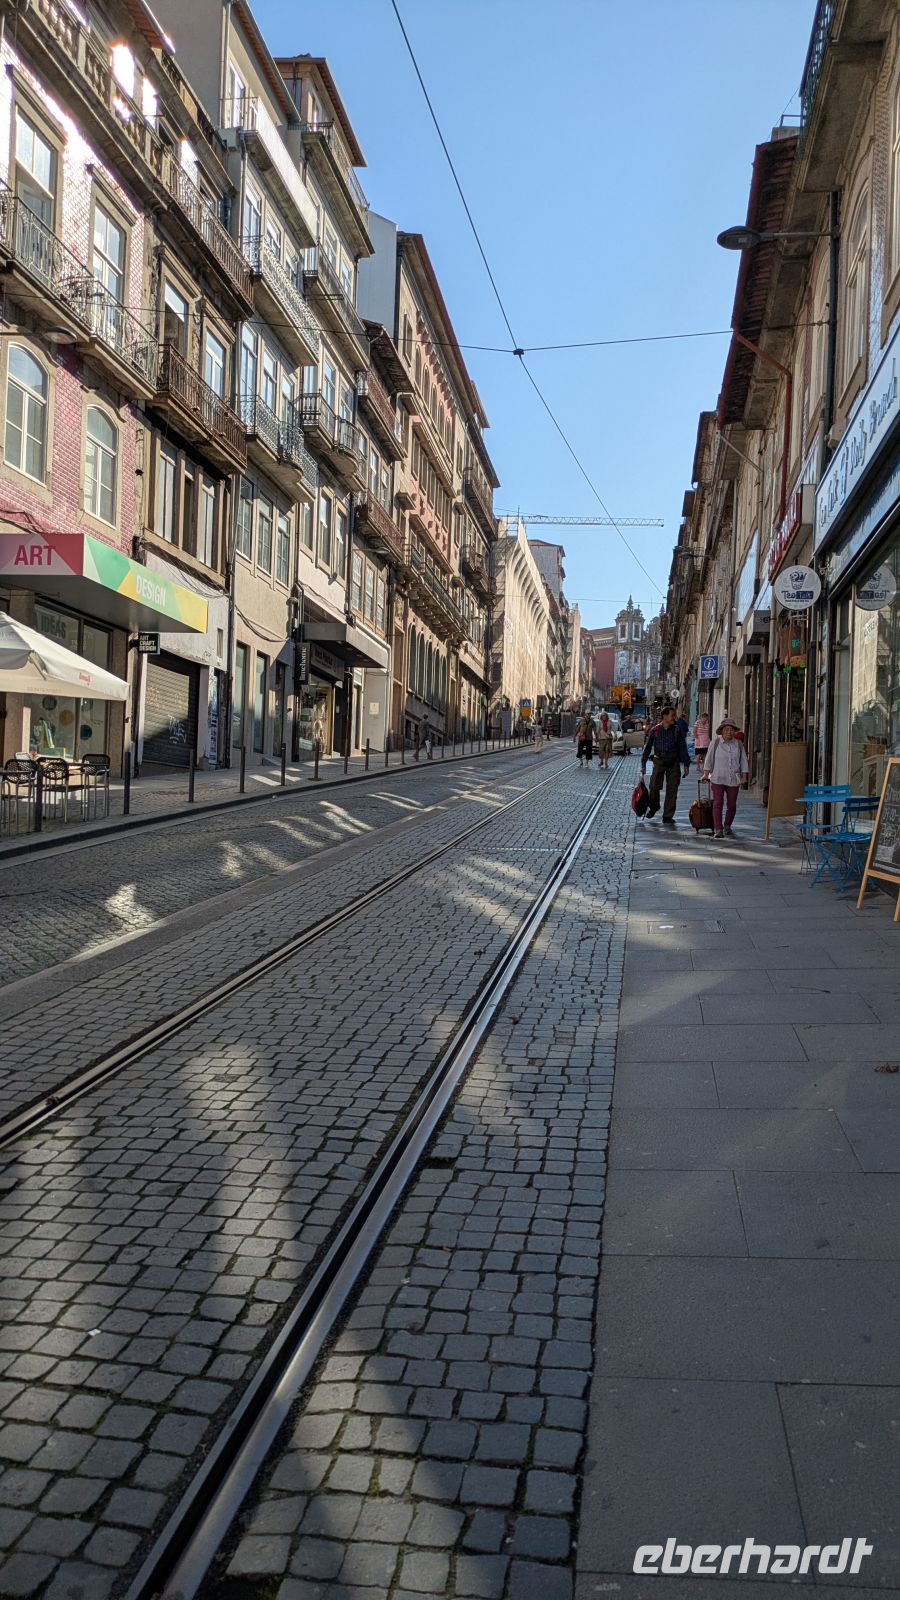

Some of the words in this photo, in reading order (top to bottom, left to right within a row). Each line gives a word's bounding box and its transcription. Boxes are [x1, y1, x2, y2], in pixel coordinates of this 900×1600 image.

[14, 545, 56, 566] ART
[136, 575, 167, 607] DESIGN
[41, 614, 66, 639] IDEAS
